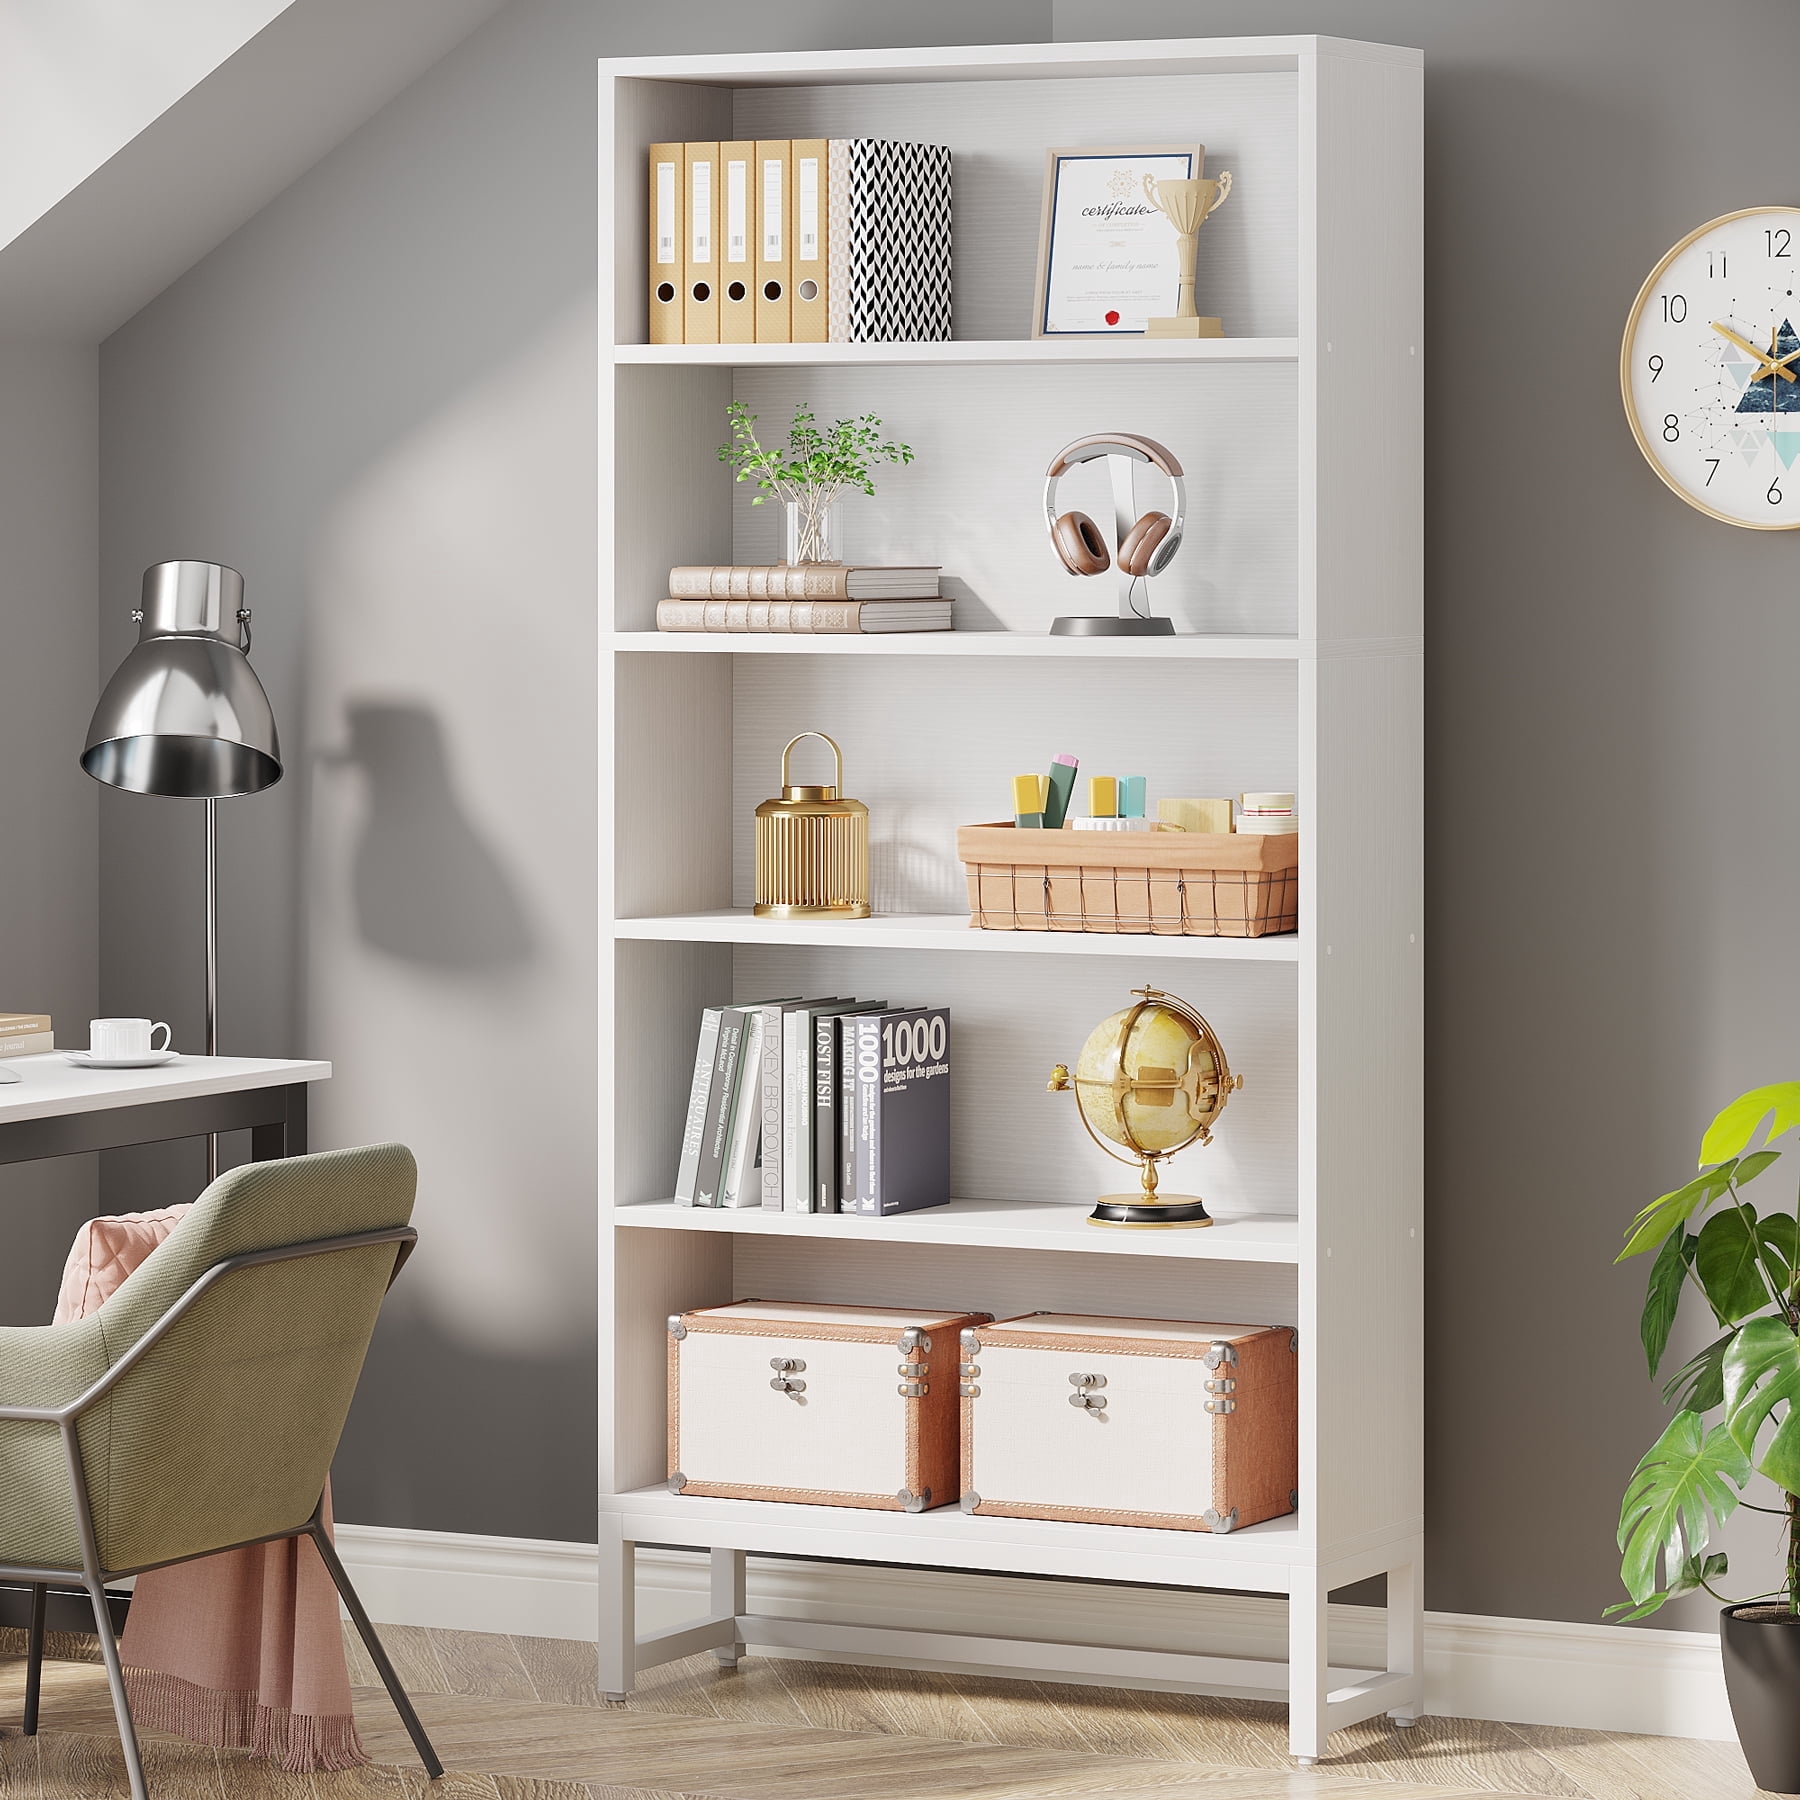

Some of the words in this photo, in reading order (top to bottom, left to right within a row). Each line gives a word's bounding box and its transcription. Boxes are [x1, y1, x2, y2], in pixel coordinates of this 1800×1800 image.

[1082, 201, 1158, 220] certificate
[1765, 229, 1791, 258] 12
[1707, 251, 1727, 278] 11
[1661, 294, 1687, 323] 10
[1648, 354, 1664, 383] 9
[1663, 413, 1680, 442] 8
[1704, 459, 1720, 487] 7
[1766, 476, 1783, 505] 6
[731, 1027, 740, 1045] Detail
[764, 1012, 779, 1081] ALEXEY
[817, 1022, 832, 1066] LOST
[843, 1025, 855, 1076] MAKING
[882, 1015, 946, 1067] 1000
[858, 1023, 879, 1084] 1000
[722, 1051, 736, 1093] Contemporary
[843, 1078, 855, 1092] IT
[884, 1069, 906, 1084] designs
[906, 1066, 915, 1080] for
[915, 1064, 925, 1078] the
[925, 1061, 949, 1079] gardens
[817, 1069, 832, 1108] FISH
[689, 1059, 712, 1156] ANTIQUAIRES
[764, 1085, 779, 1198] BRODOVITCH
